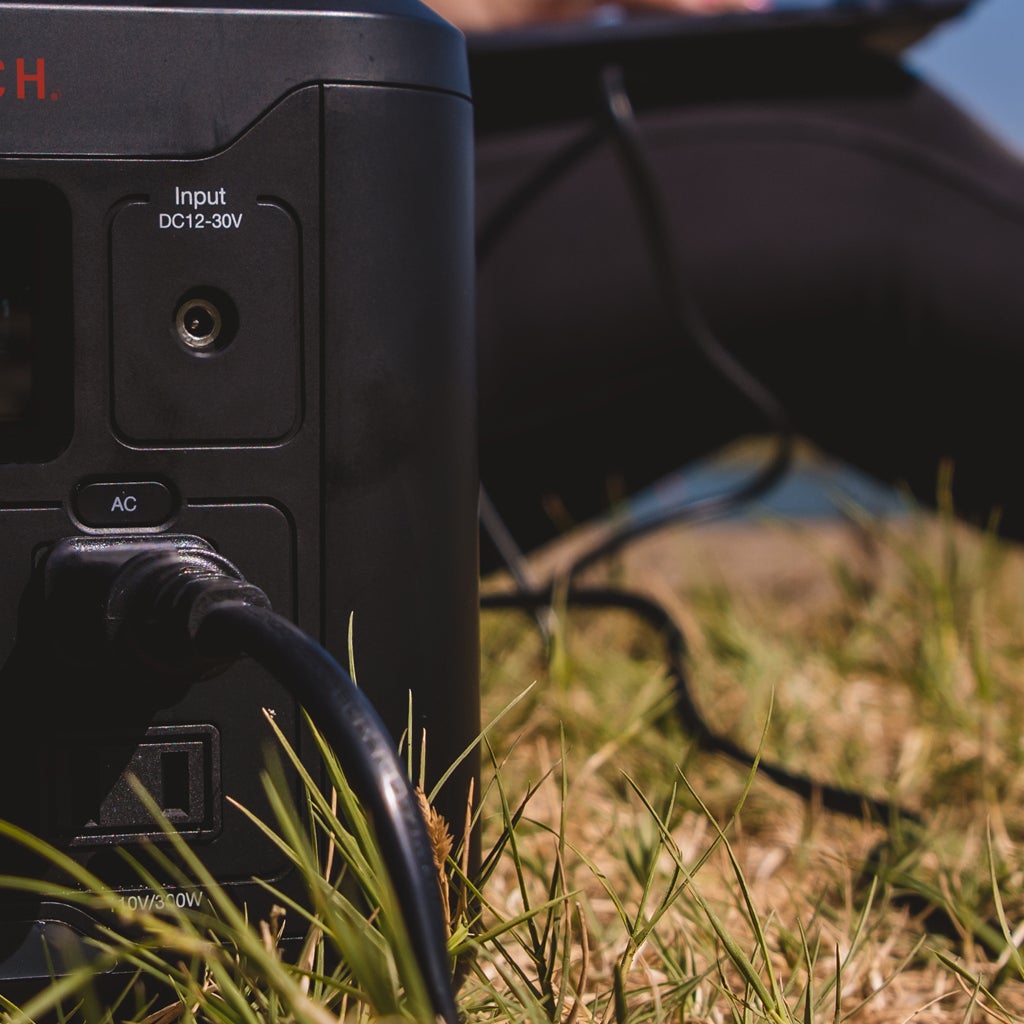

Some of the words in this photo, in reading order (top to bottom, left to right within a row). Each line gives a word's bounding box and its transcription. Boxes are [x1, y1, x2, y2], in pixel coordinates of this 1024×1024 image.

[175, 186, 227, 210] Input
[159, 212, 243, 229] DC12-30V
[110, 491, 137, 512] AC
